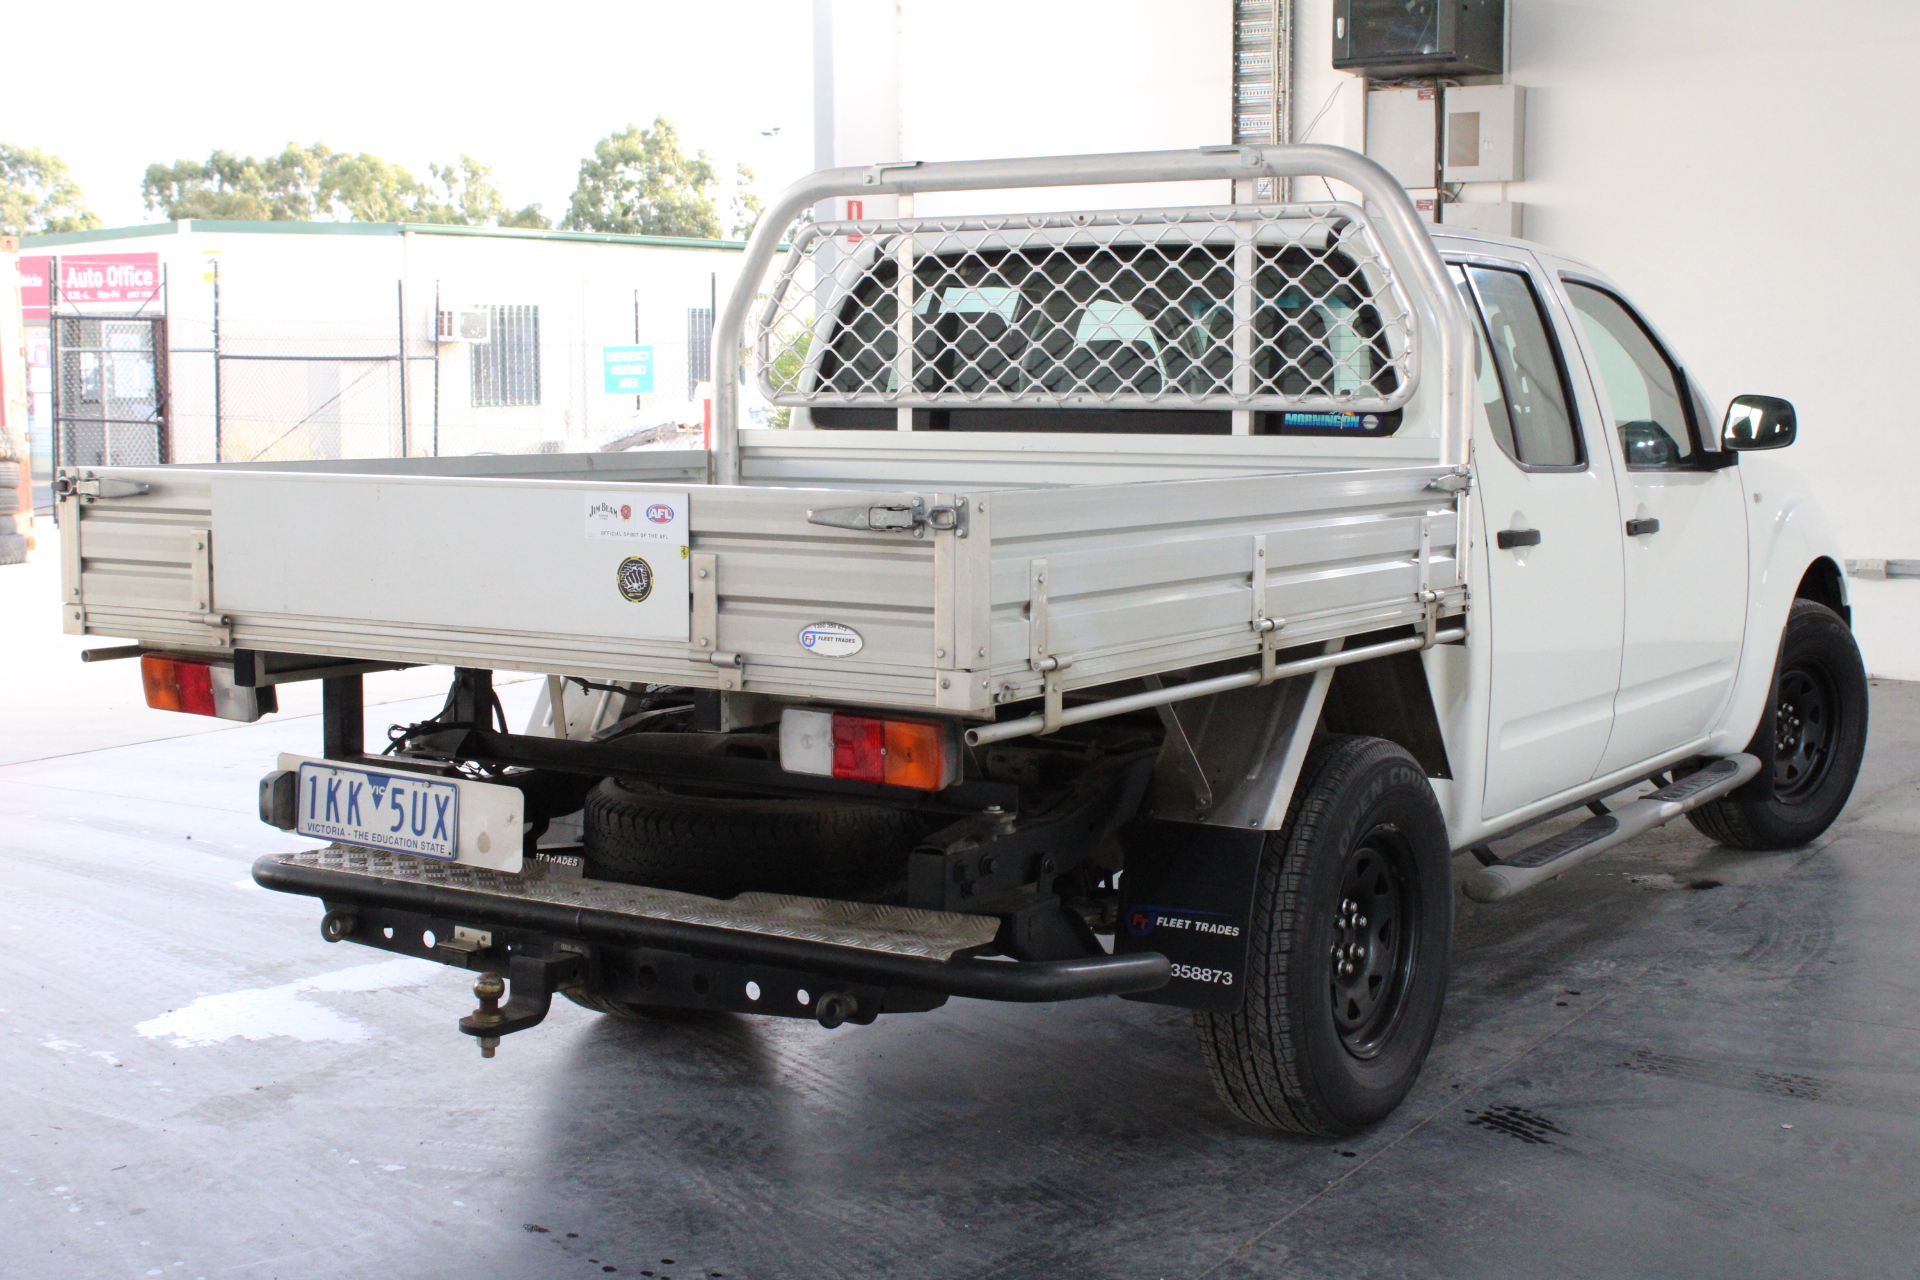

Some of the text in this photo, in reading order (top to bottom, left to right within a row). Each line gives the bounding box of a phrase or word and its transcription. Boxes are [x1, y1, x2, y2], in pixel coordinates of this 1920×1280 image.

[20, 274, 43, 287] hicle
[67, 265, 153, 288] Auto Office
[605, 350, 650, 362] EMERGENCY
[610, 364, 647, 375] ASSEMBLY
[619, 378, 640, 388] AREA
[589, 504, 601, 518] JIM
[601, 502, 618, 518] BEAM
[649, 508, 673, 520] AFL
[370, 785, 387, 796] VIC
[309, 775, 450, 841] 1KK 5UX
[307, 822, 345, 837] VICTORIA
[353, 830, 369, 841] THE
[371, 832, 418, 849] EDUCATION
[420, 841, 446, 854] STATE
[1132, 913, 1150, 930] FT
[1156, 916, 1240, 937] FLEET TRADES
[1171, 963, 1234, 986] 358873
